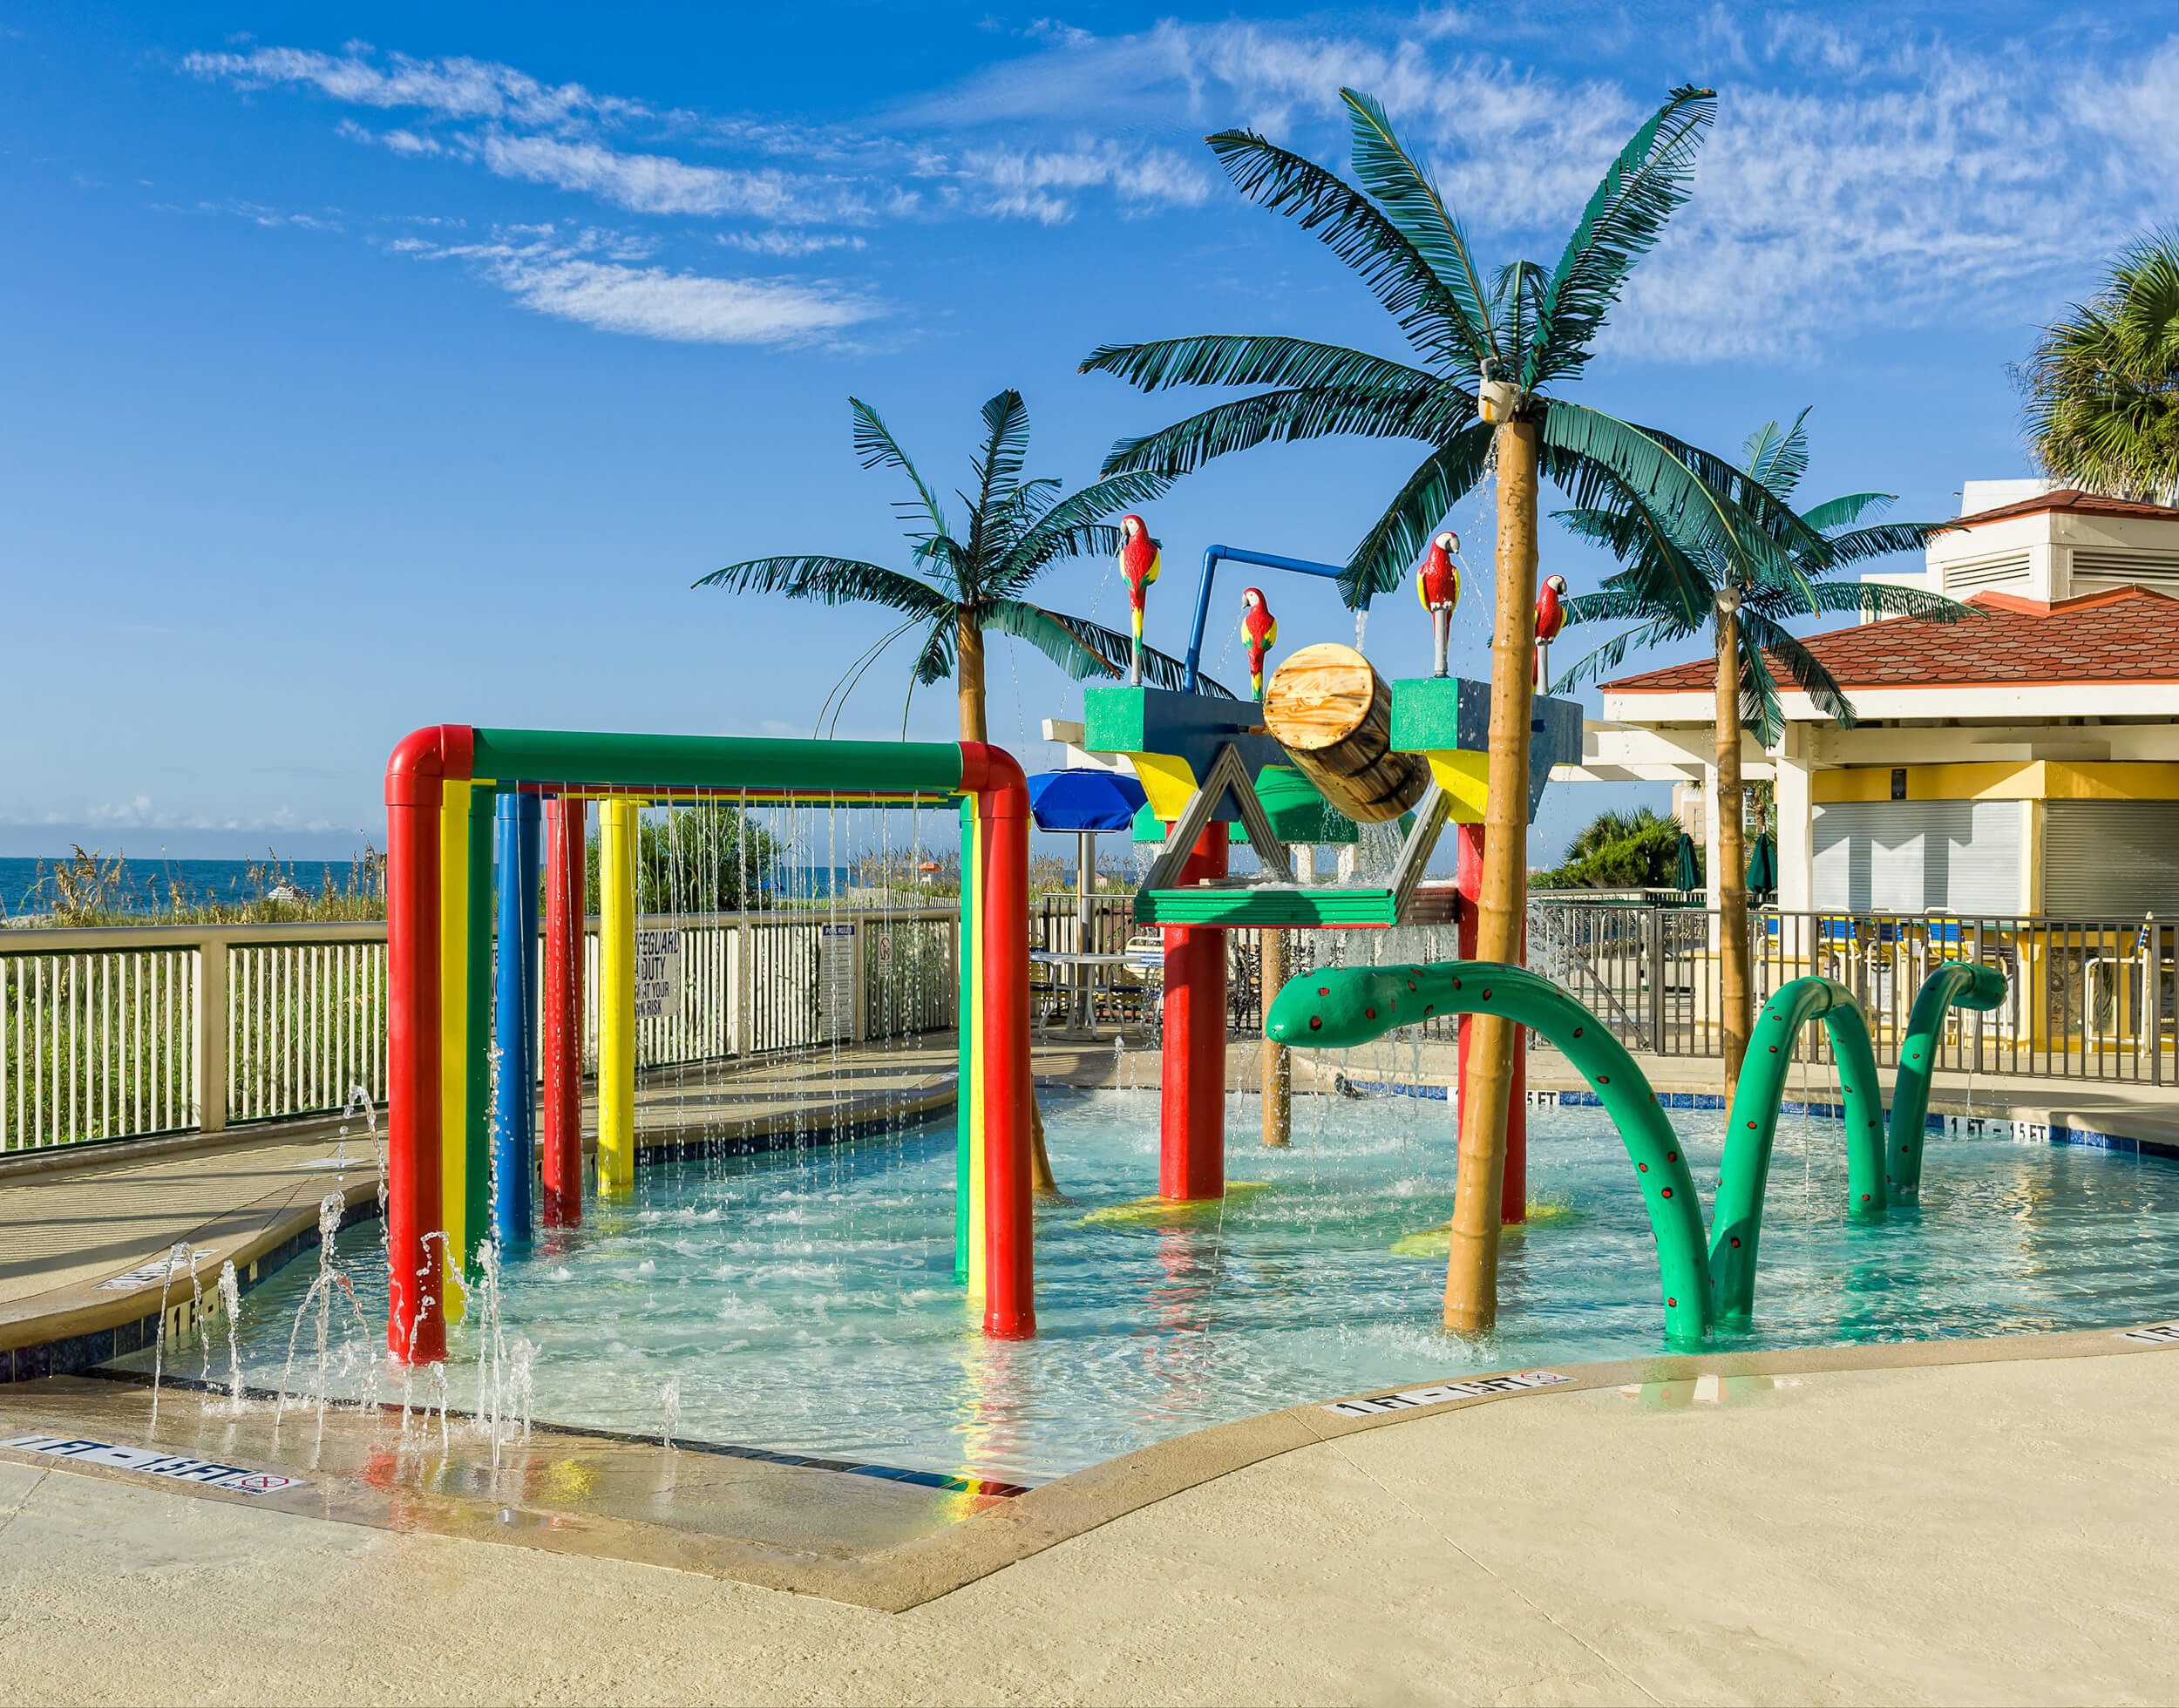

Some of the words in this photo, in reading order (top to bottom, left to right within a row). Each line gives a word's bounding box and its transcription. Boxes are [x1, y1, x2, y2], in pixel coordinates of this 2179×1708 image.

[635, 932, 680, 956] IFEGUARD
[641, 957, 666, 981] DUTY
[652, 981, 669, 998] YOUR
[647, 999, 662, 1016] RISK
[1526, 1091, 1533, 1105] 5
[1538, 1091, 1557, 1105] FT
[1967, 1118, 1986, 1135] FT
[2029, 1124, 2047, 1139] FT
[1336, 1403, 1375, 1413] 1
[1362, 1394, 1421, 1409] FT
[36, 1440, 117, 1455] FT
